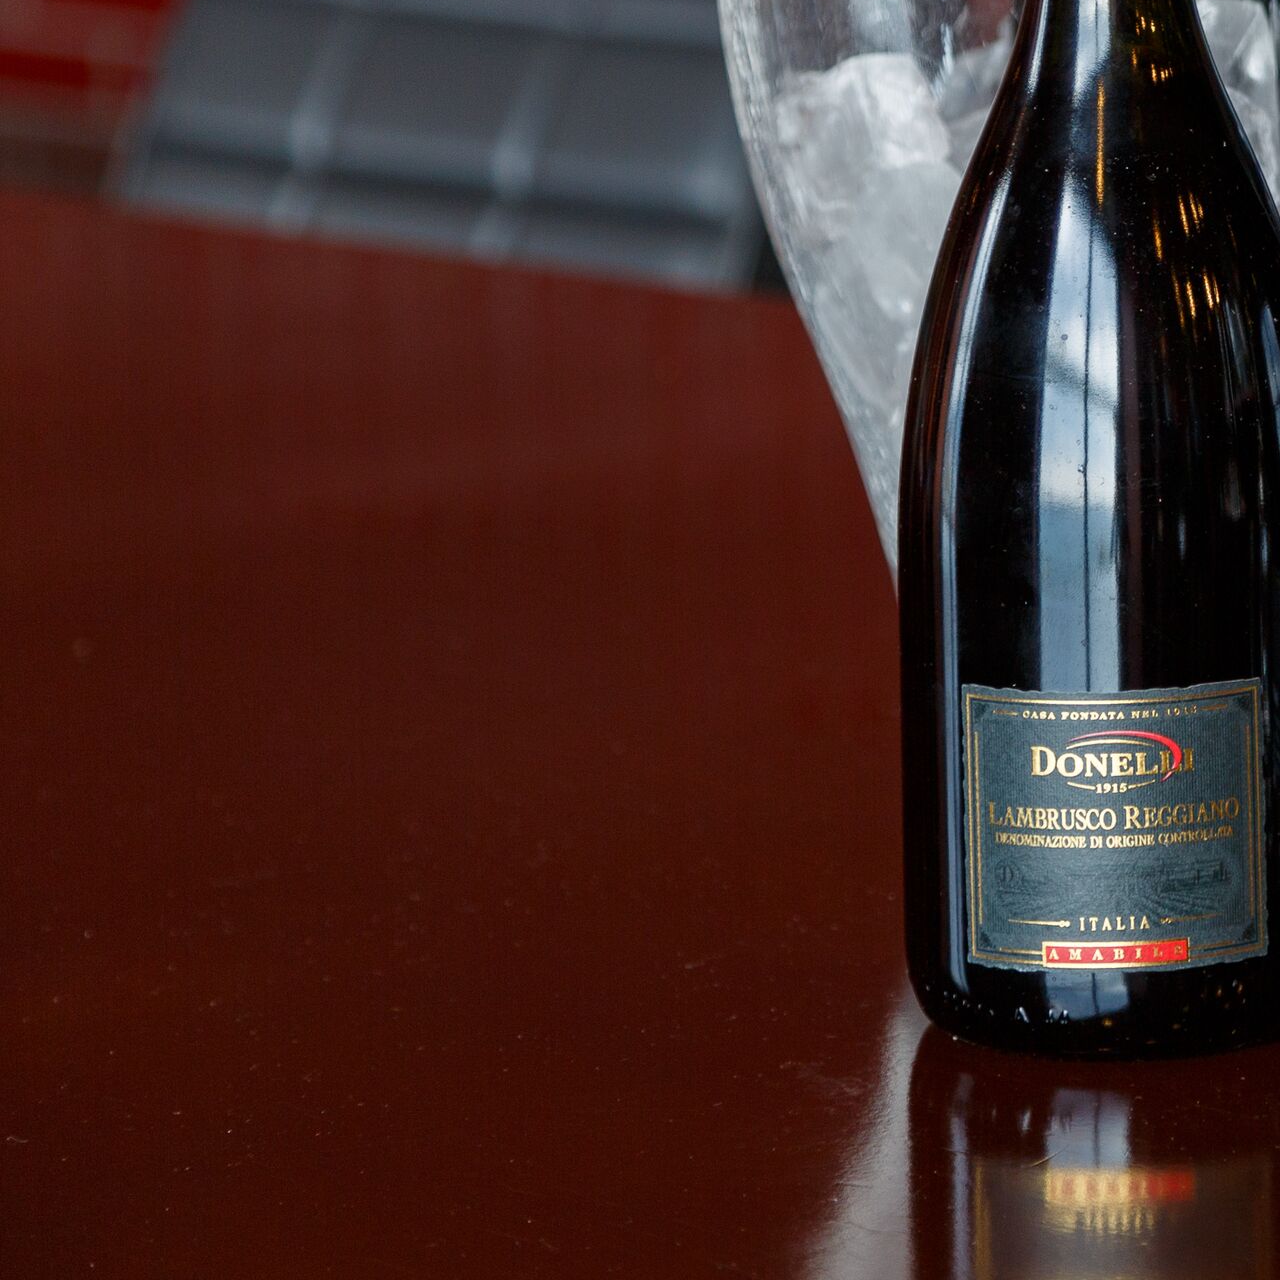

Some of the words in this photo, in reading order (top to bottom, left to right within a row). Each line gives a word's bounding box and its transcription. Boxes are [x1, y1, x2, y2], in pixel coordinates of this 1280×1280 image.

[1022, 710, 1056, 720] CASA
[1061, 710, 1125, 721] FONDATA
[1131, 710, 1159, 719] NEL
[1030, 745, 1195, 778] DONELLI
[1096, 783, 1127, 793] 1915
[988, 801, 1117, 831] LAMBRUSCO
[1123, 797, 1240, 830] REGGIANO
[995, 831, 1087, 849] DENOMINAZIONE
[1090, 835, 1103, 849] DI
[1106, 833, 1154, 849] ORIGINE
[1158, 825, 1233, 846] CONTROLLATA
[1079, 915, 1150, 932] ITALIA
[1049, 943, 1184, 961] AMABILE
